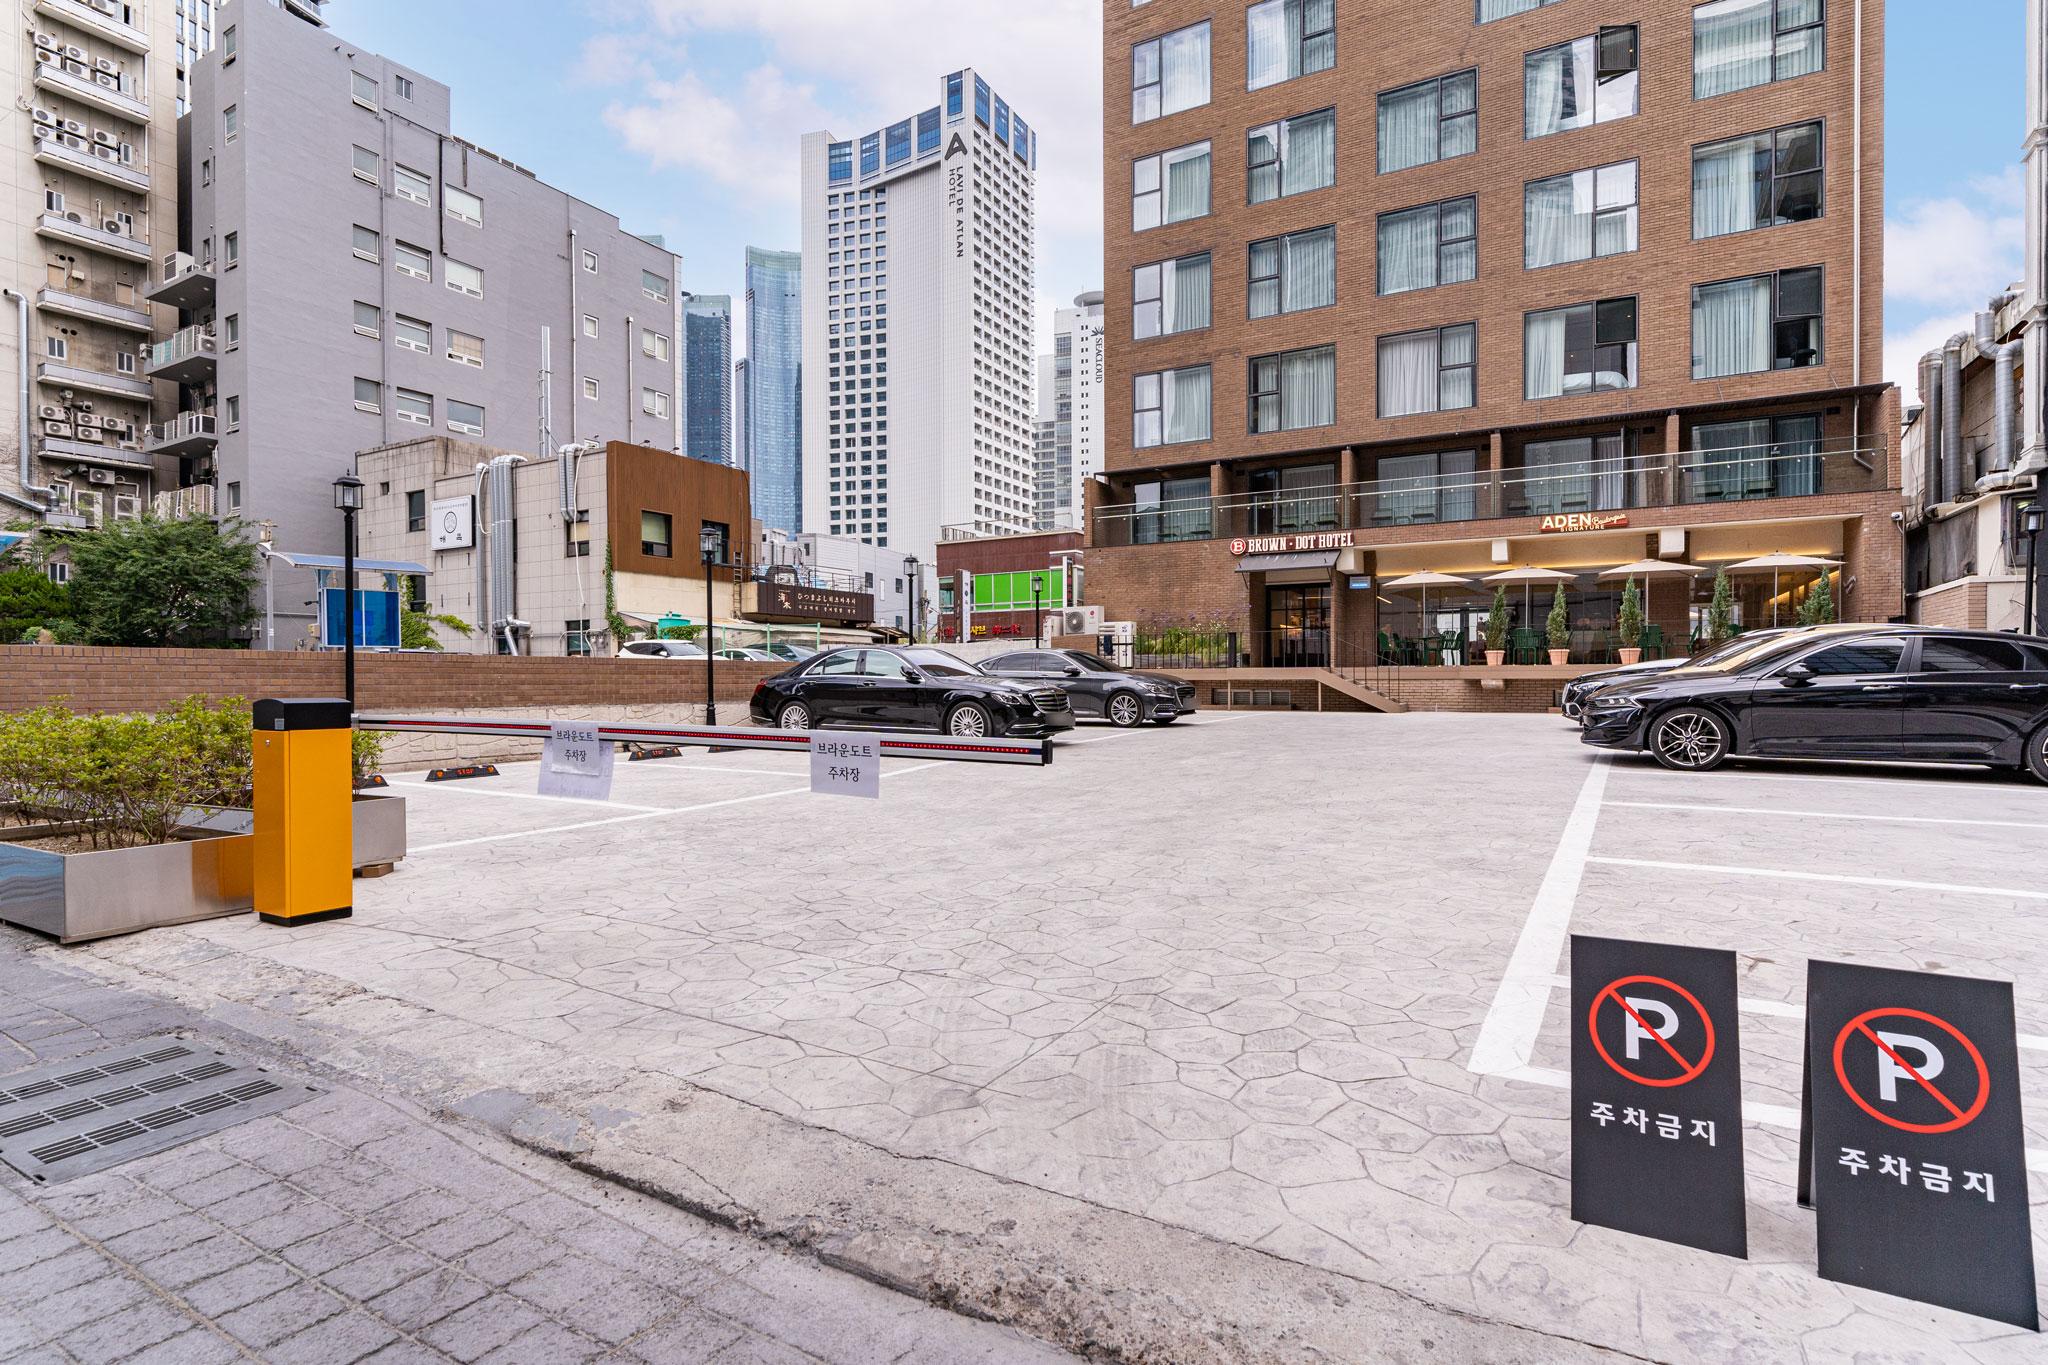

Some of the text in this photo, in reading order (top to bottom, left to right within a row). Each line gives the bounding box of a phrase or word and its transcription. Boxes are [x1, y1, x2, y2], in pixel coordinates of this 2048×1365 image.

[948, 169, 956, 207] HOTEL
[956, 166, 964, 258] LAVI DE ATLAN
[1095, 337, 1103, 384] SEACLOUD
[1542, 513, 1592, 529] ADEN
[1560, 524, 1605, 532] SIGNATURE
[1247, 537, 1287, 553] BROWN
[1295, 535, 1317, 550] DOT
[1318, 532, 1354, 548] HOTEL
[556, 729, 594, 743] 브라운도트
[816, 742, 872, 758] 브라운도트
[564, 749, 586, 762] 주차장
[827, 766, 861, 783] 주차장
[1624, 996, 1679, 1060] P
[1876, 1030, 1944, 1102] P
[1589, 1101, 1717, 1147] 주차금지
[1838, 1146, 1996, 1203] 주차금지
